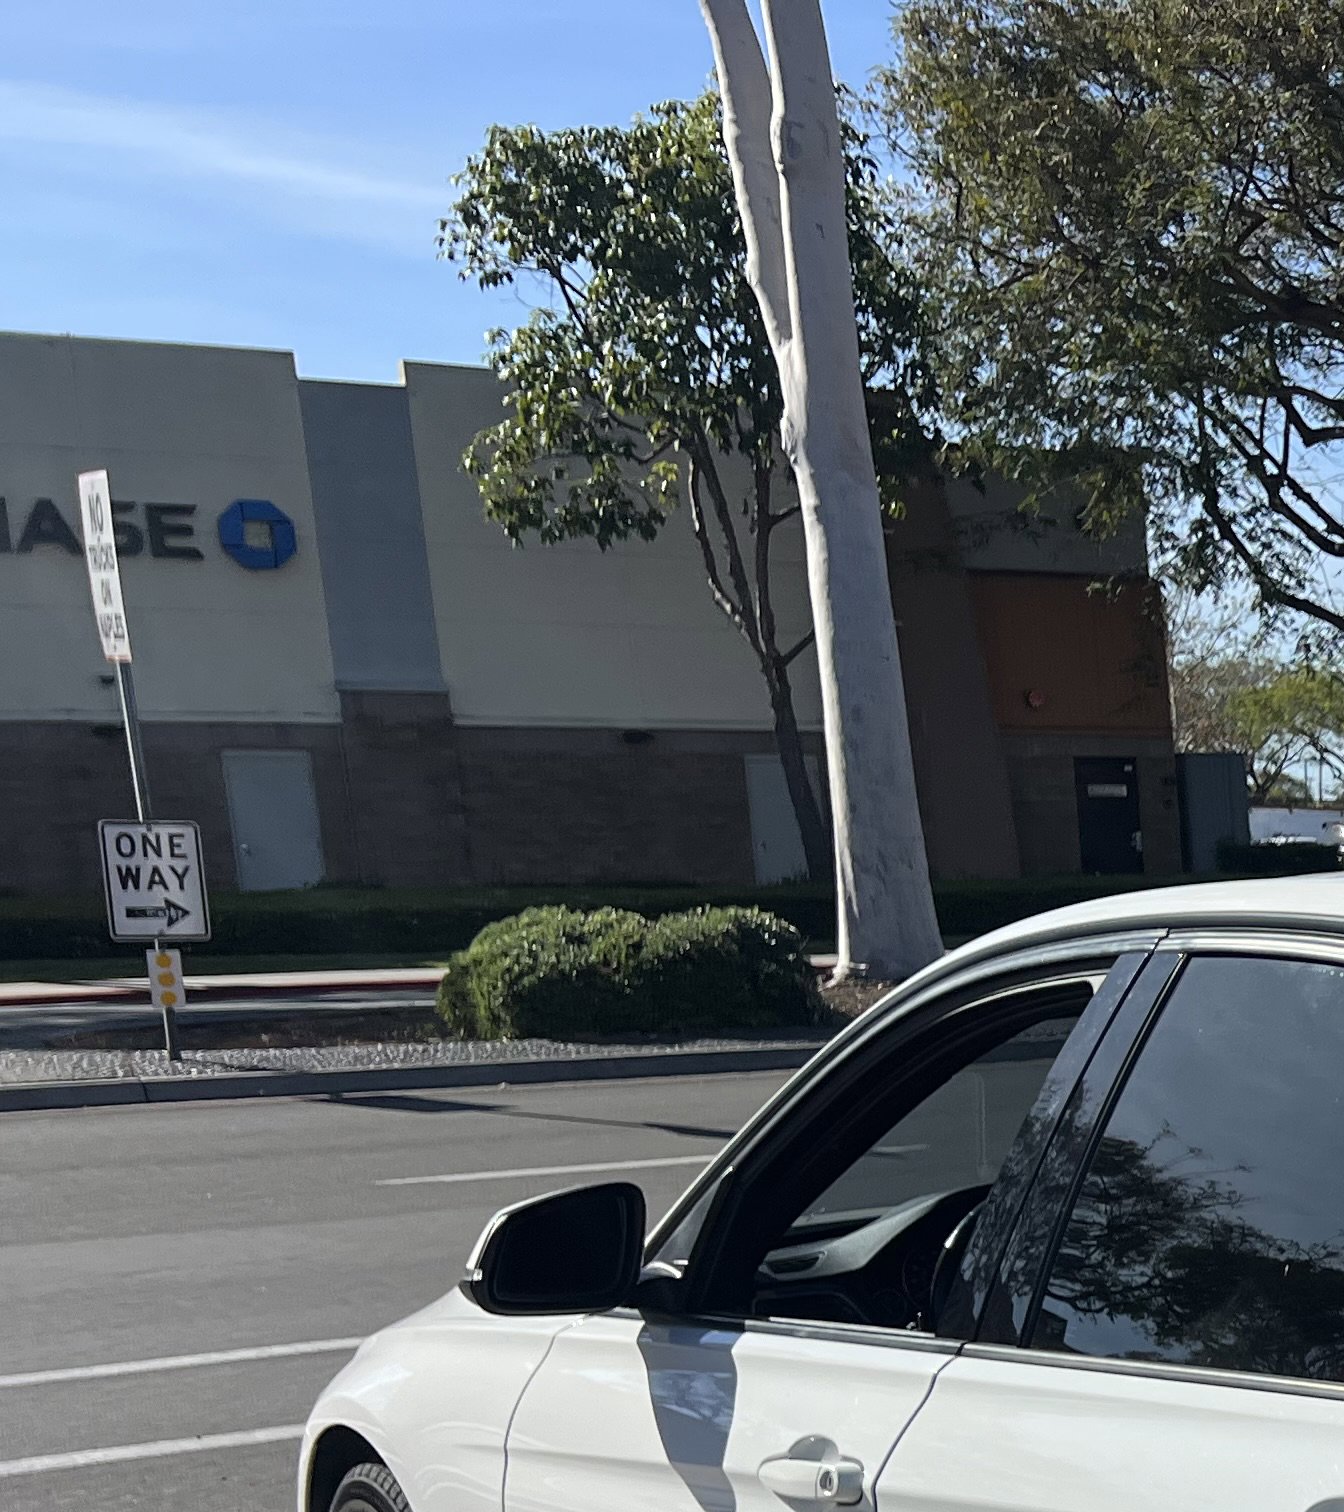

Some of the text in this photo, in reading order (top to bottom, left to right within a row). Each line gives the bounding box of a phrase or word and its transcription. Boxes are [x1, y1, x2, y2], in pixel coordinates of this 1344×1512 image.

[87, 492, 105, 535] NO
[115, 831, 188, 859] ONE
[116, 864, 190, 892] WAY
